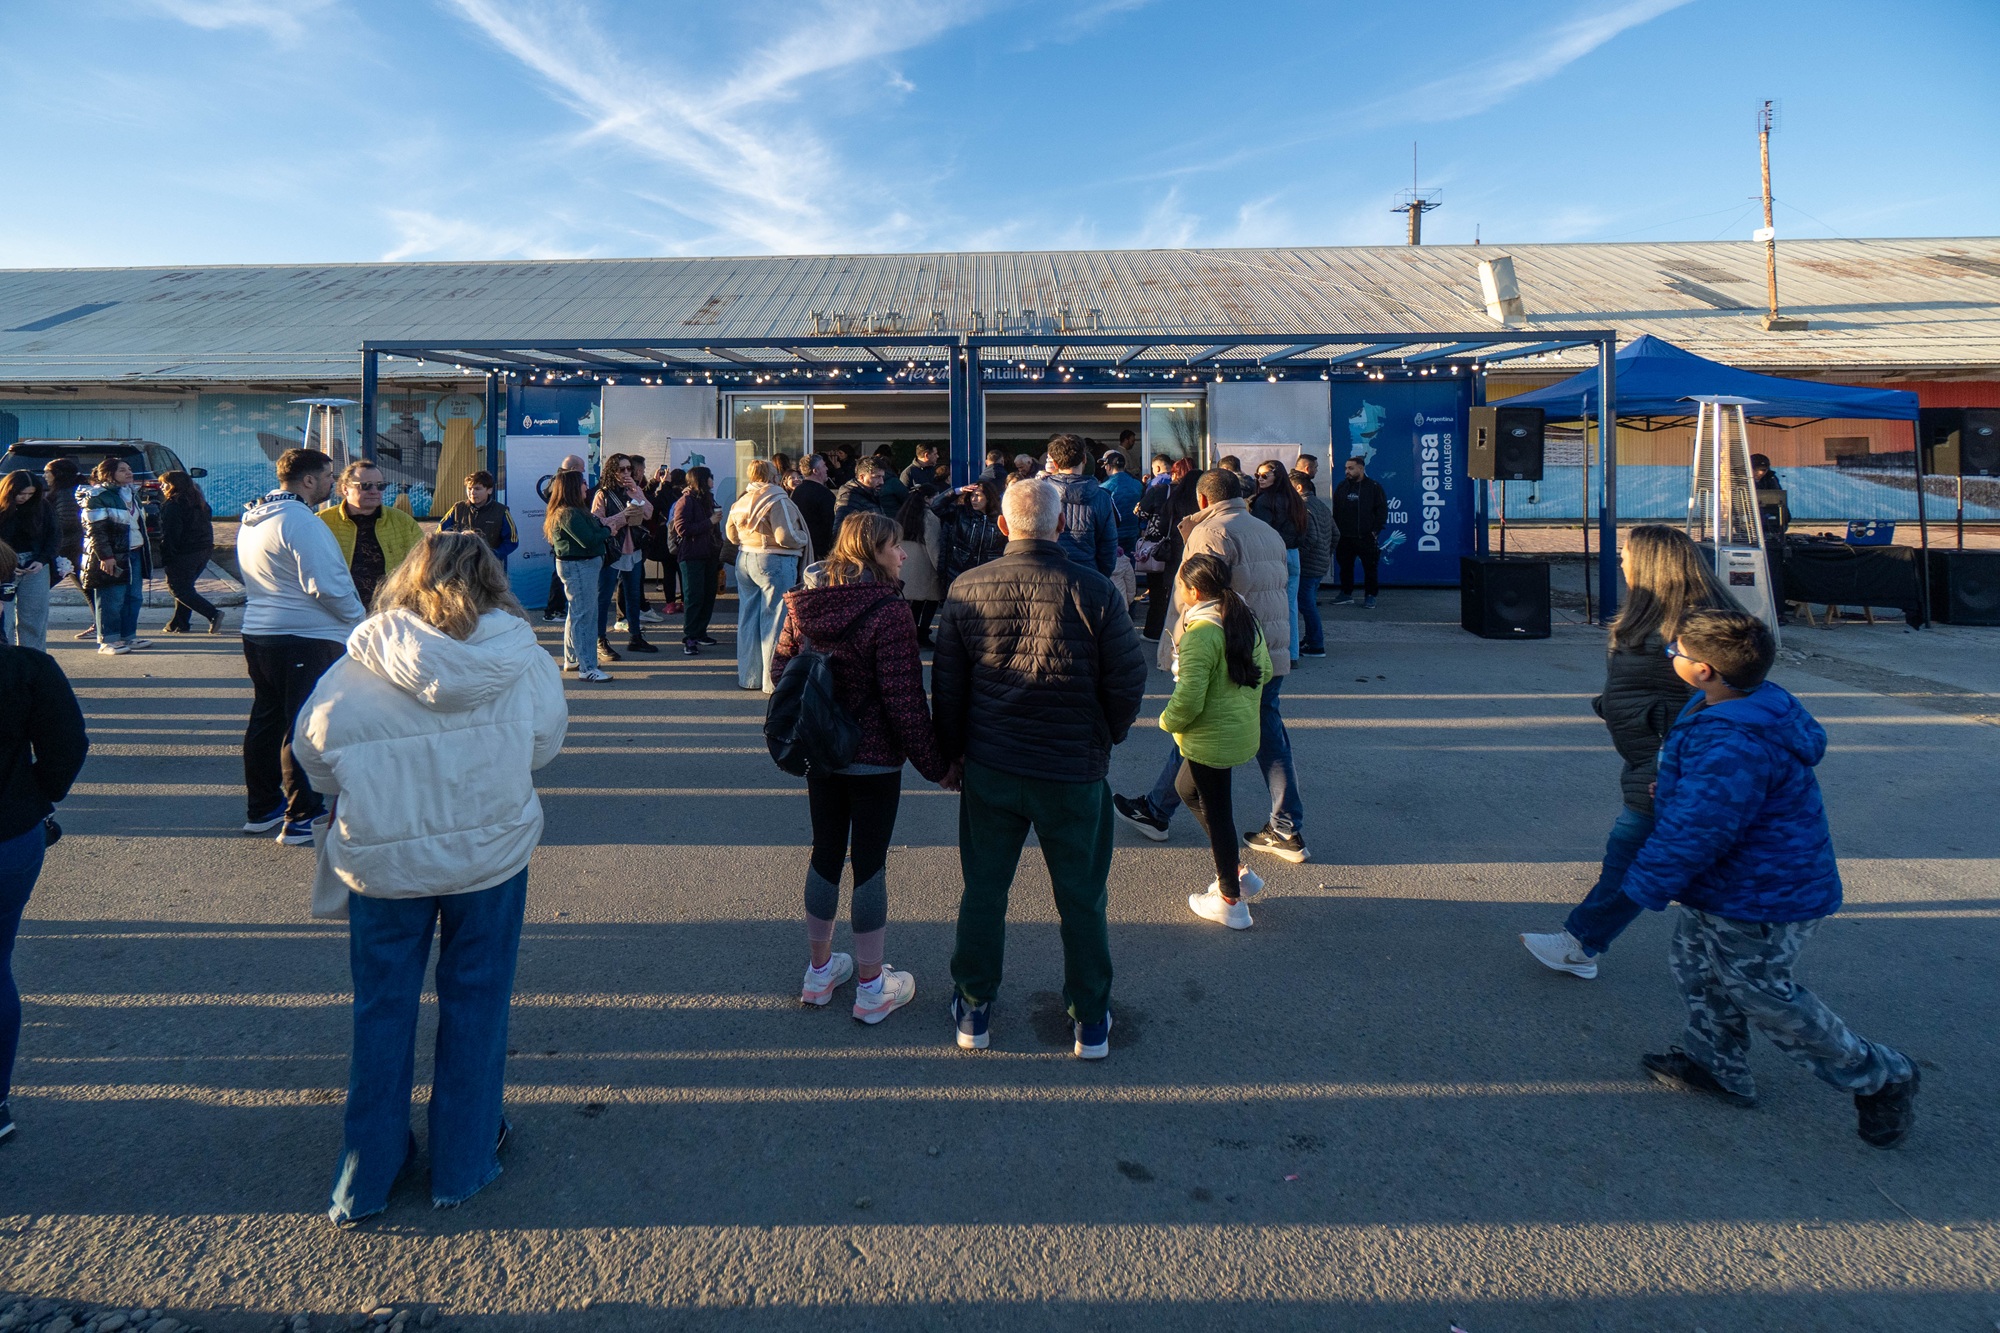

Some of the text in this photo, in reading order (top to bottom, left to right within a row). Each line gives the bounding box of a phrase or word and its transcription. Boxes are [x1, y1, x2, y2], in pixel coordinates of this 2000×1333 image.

[533, 418, 559, 426] Argentina
[1442, 433, 1453, 490] RÍO GALLEGOS
[1417, 433, 1446, 552] Despensa
